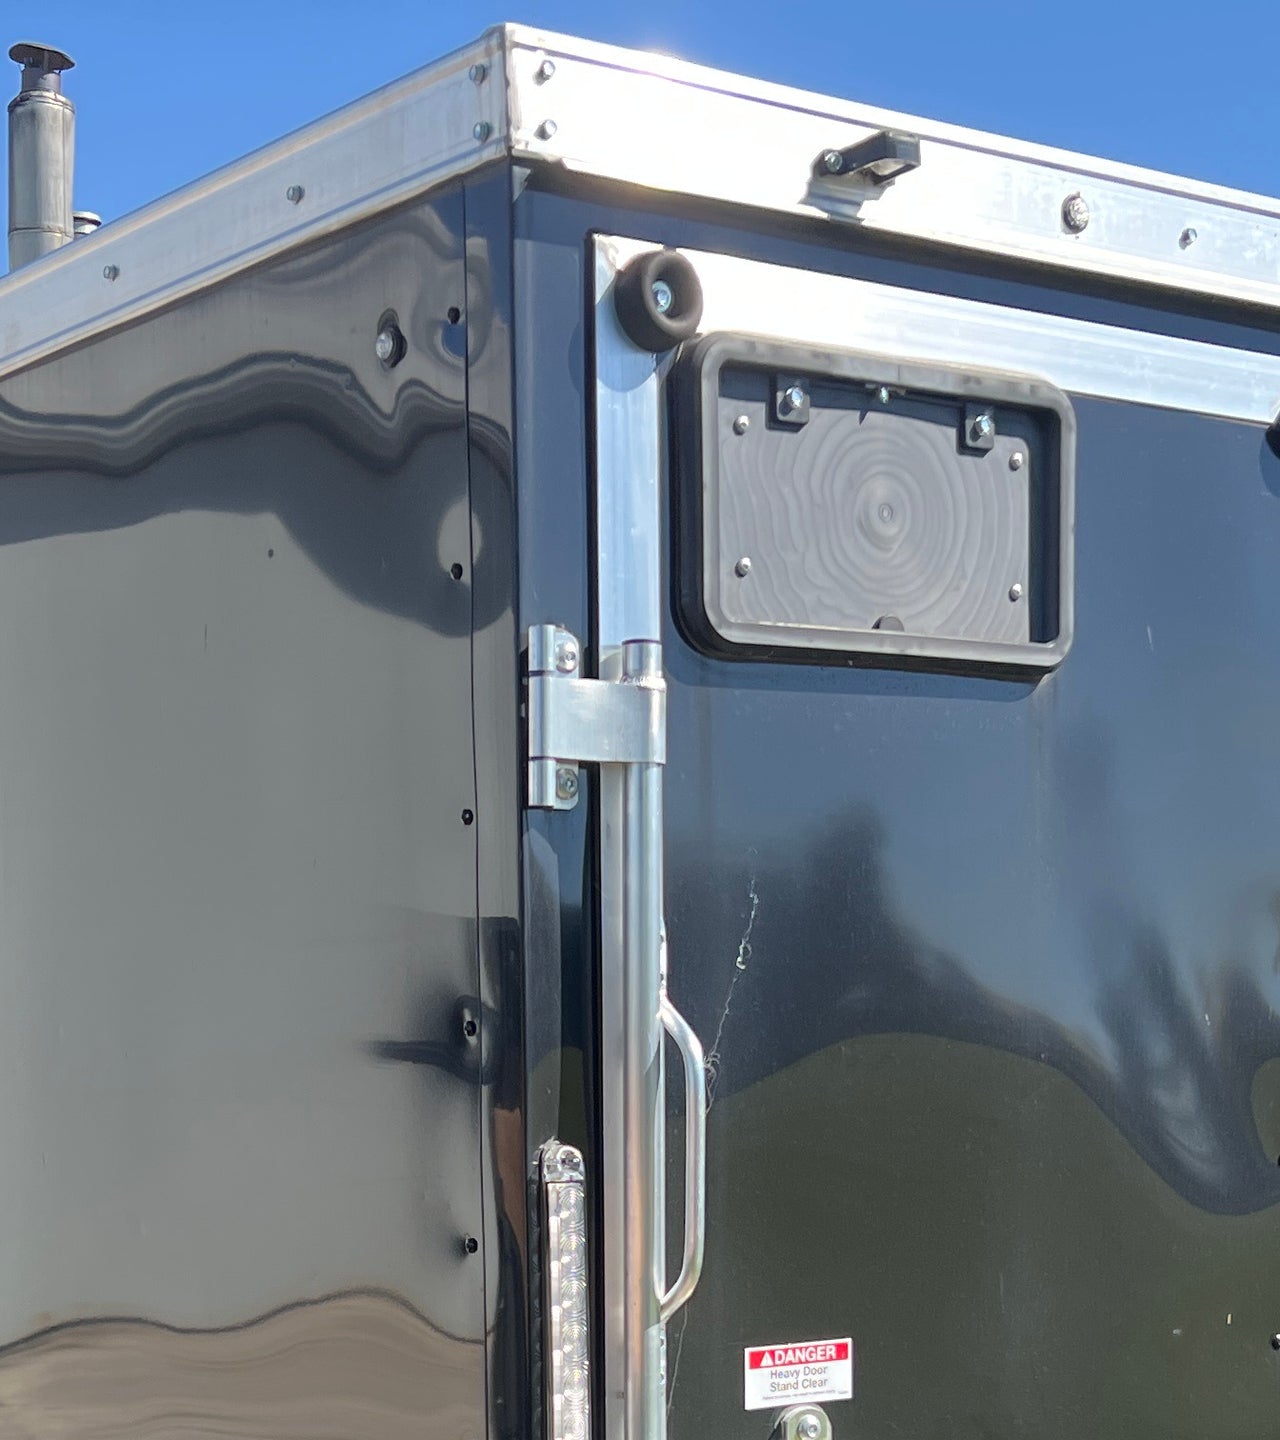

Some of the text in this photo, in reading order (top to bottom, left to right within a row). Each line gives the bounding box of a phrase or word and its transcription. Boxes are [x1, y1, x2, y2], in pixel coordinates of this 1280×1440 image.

[774, 1344, 837, 1365] DANGER
[770, 1365, 828, 1380] Heavy Door
[769, 1377, 828, 1393] Stand Clear
